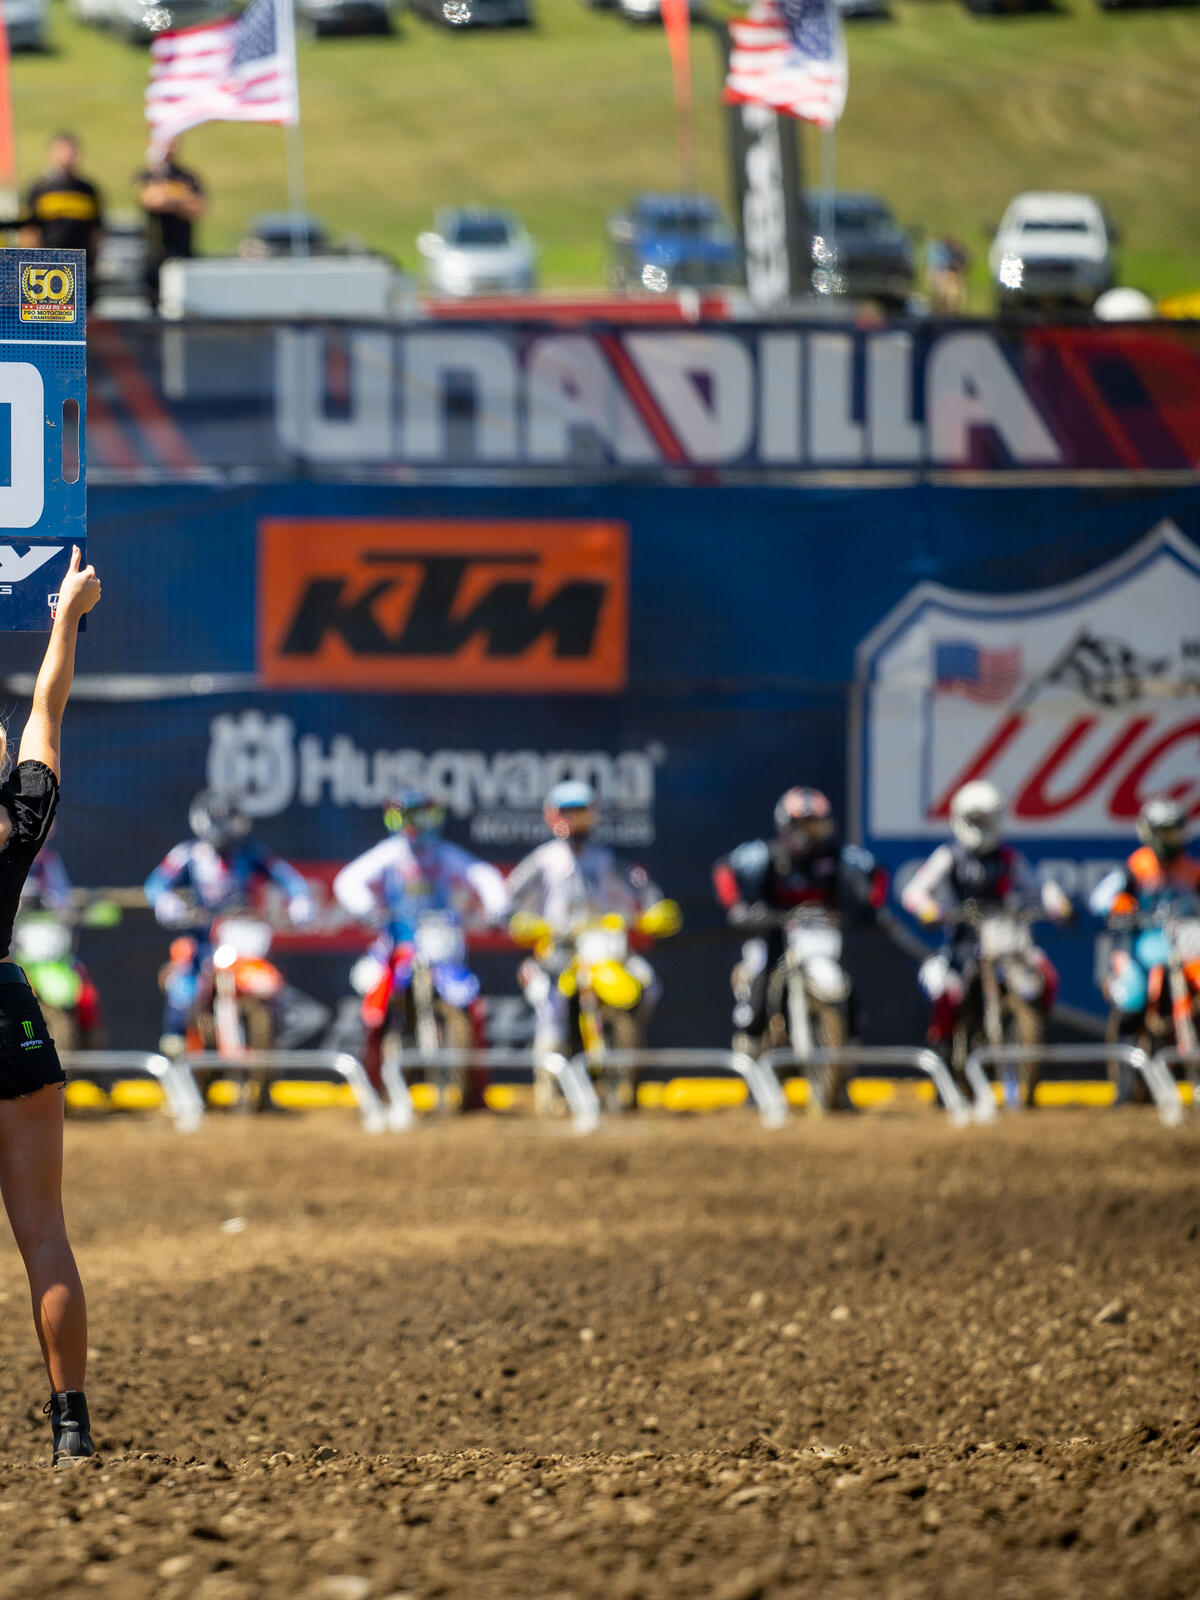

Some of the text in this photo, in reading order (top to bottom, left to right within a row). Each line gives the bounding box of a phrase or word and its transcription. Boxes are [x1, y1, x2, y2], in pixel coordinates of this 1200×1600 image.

[29, 269, 70, 300] 50
[274, 330, 1060, 465] UNADILLA
[278, 549, 614, 660] KTM
[297, 733, 657, 820] Husqvarna
[924, 712, 1200, 822] LUC
